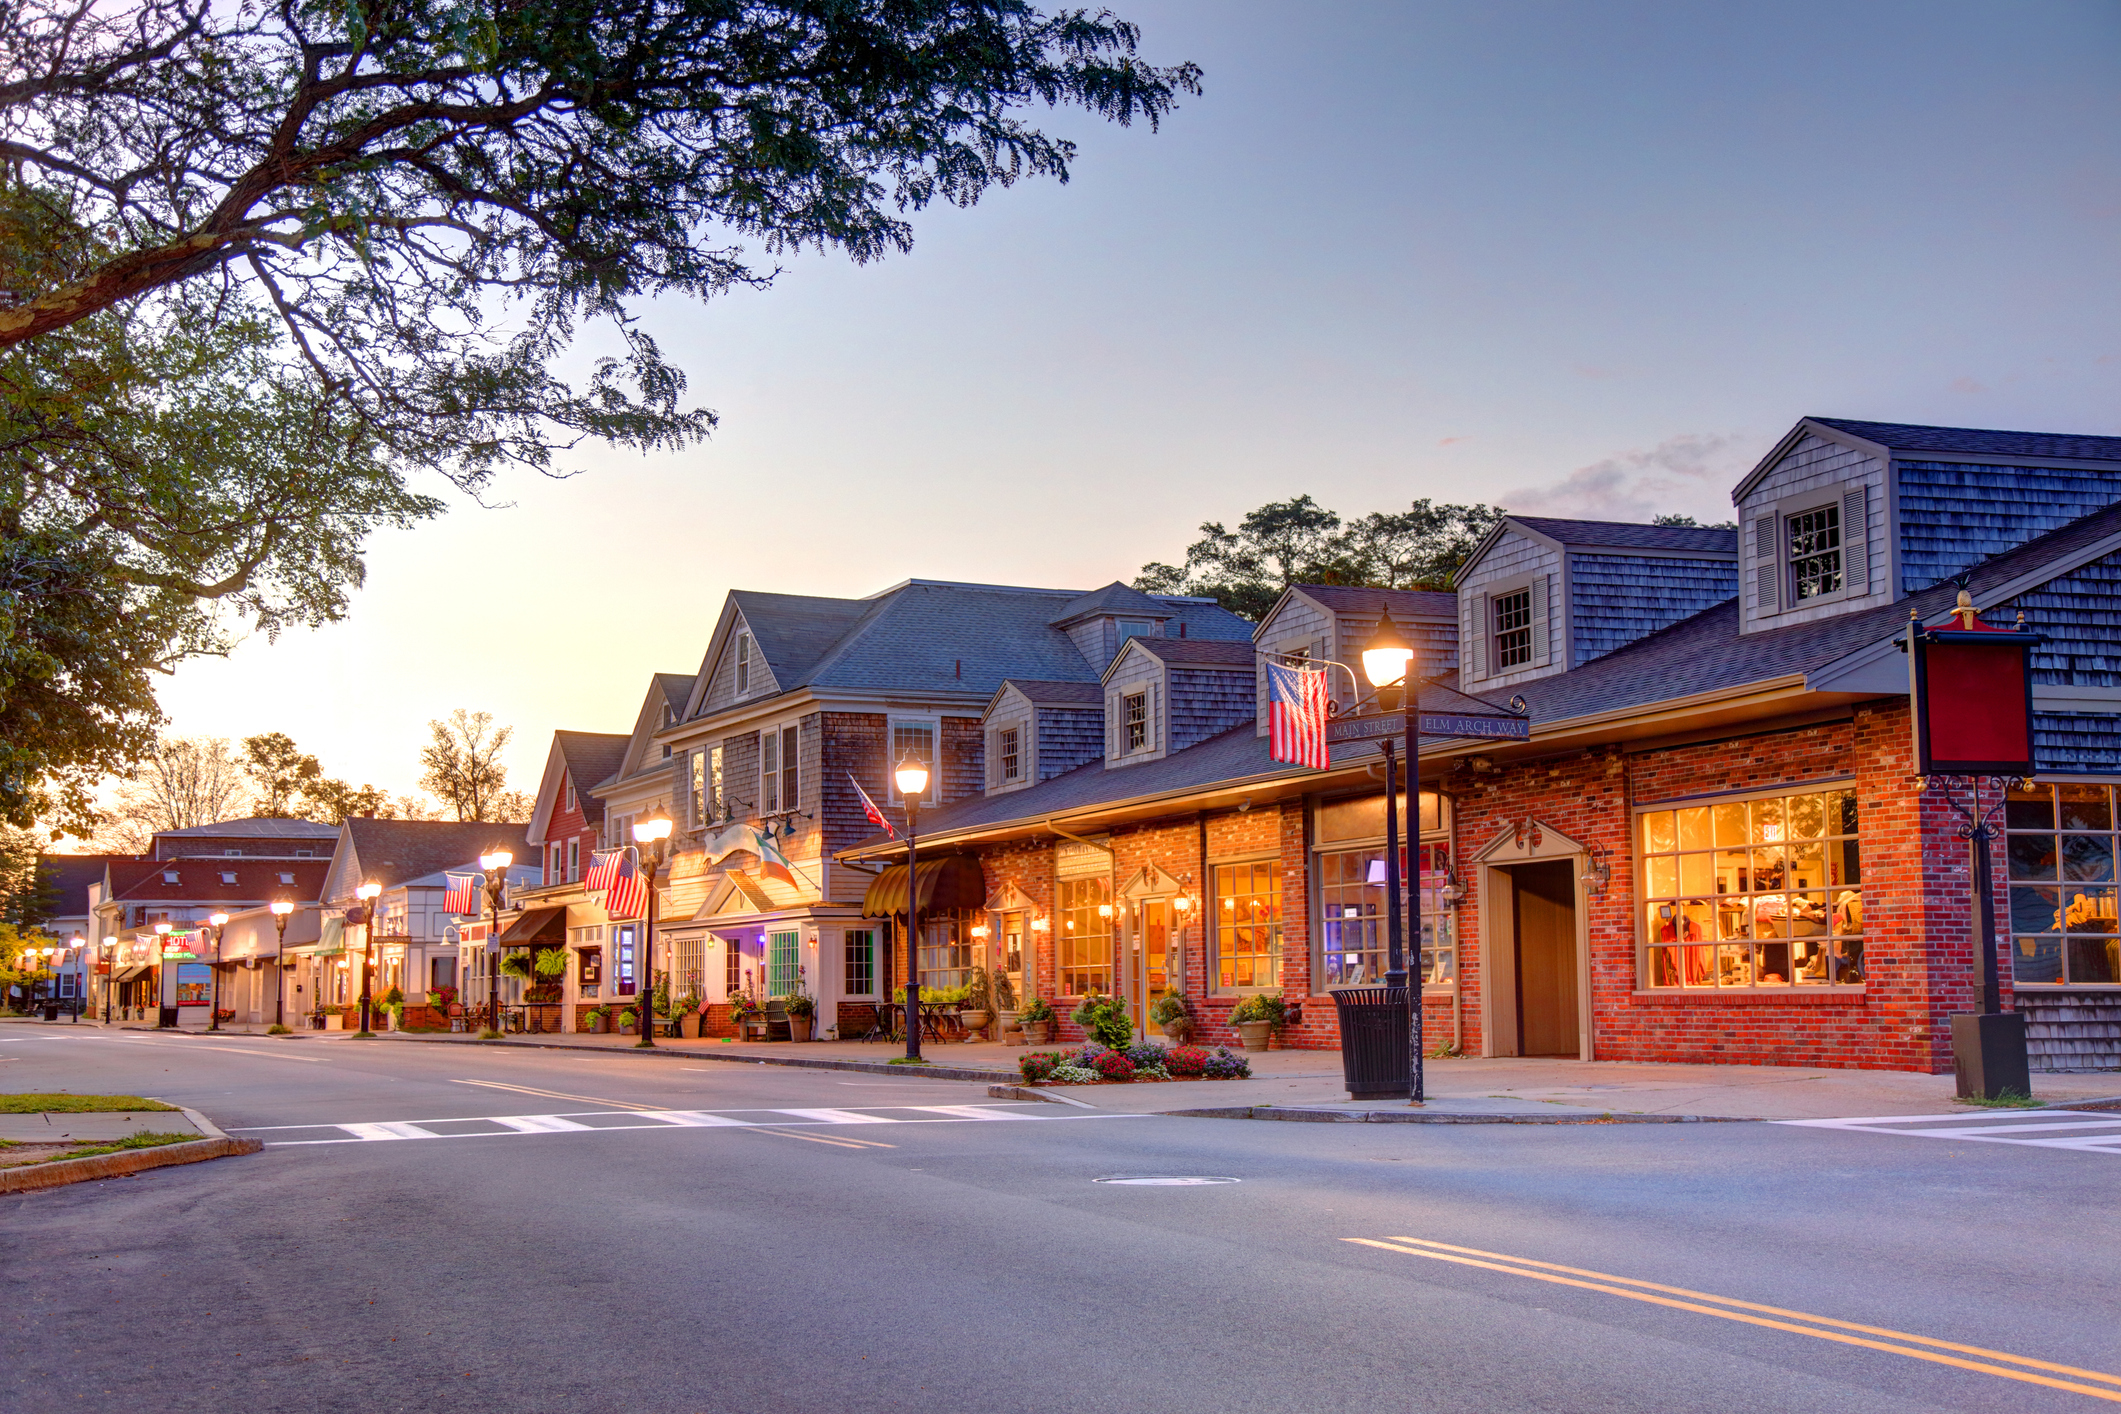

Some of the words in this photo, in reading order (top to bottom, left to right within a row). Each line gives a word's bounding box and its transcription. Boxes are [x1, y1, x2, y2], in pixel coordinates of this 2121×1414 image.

[1334, 723, 1360, 737] MAIN
[1363, 718, 1398, 733] STREET
[1425, 718, 1450, 730] ELM
[1456, 720, 1491, 732] ARCH
[1497, 722, 1525, 734] WAY
